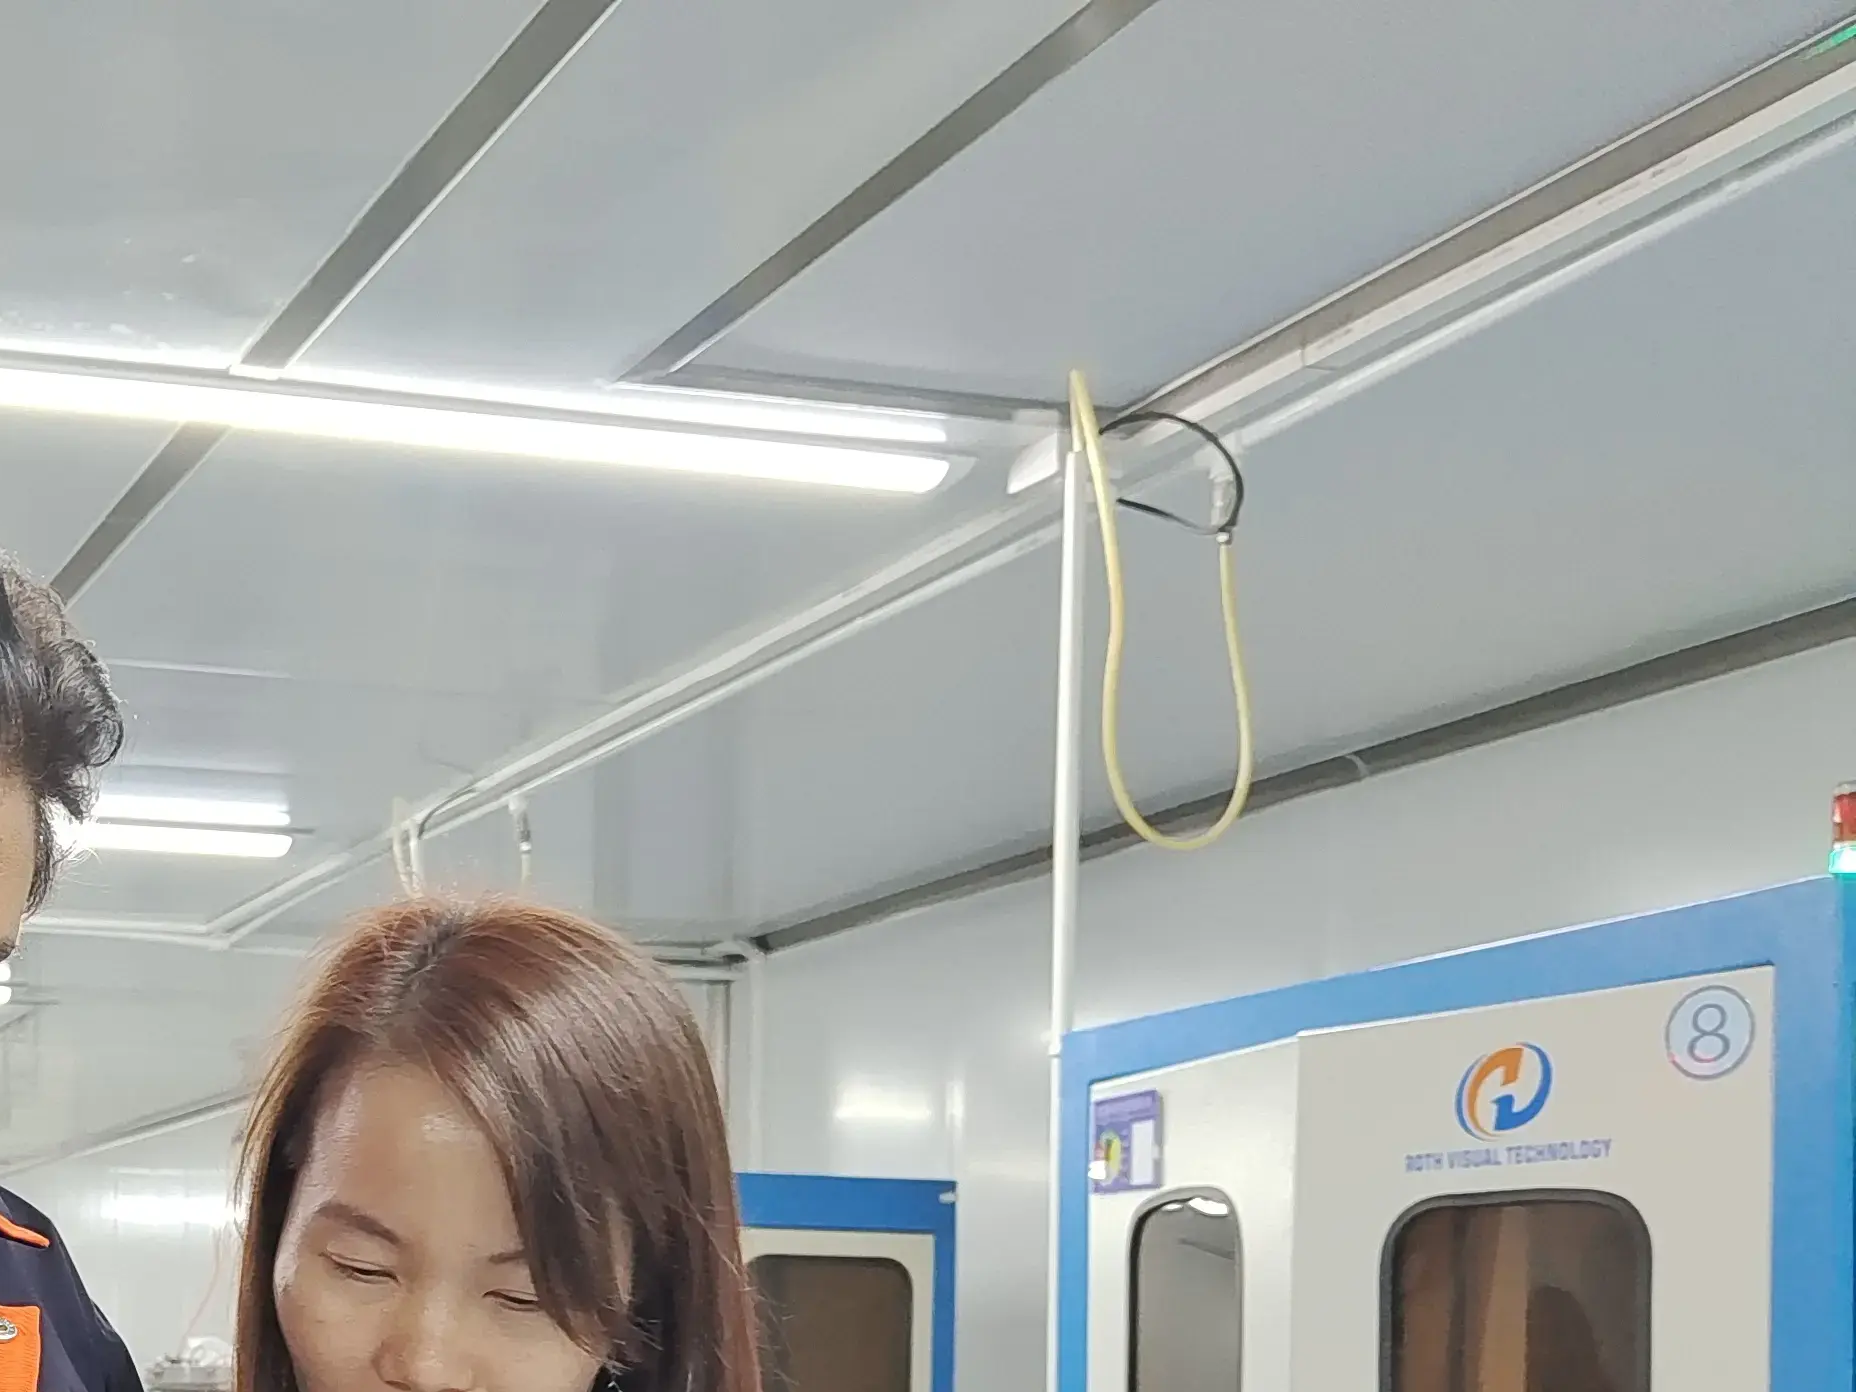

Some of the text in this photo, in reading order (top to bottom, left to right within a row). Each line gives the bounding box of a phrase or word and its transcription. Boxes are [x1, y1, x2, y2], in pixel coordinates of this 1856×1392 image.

[1687, 1003, 1730, 1063] 8
[1447, 1148, 1502, 1169] VISUAL
[1506, 1138, 1612, 1165] TECHNOLOGY
